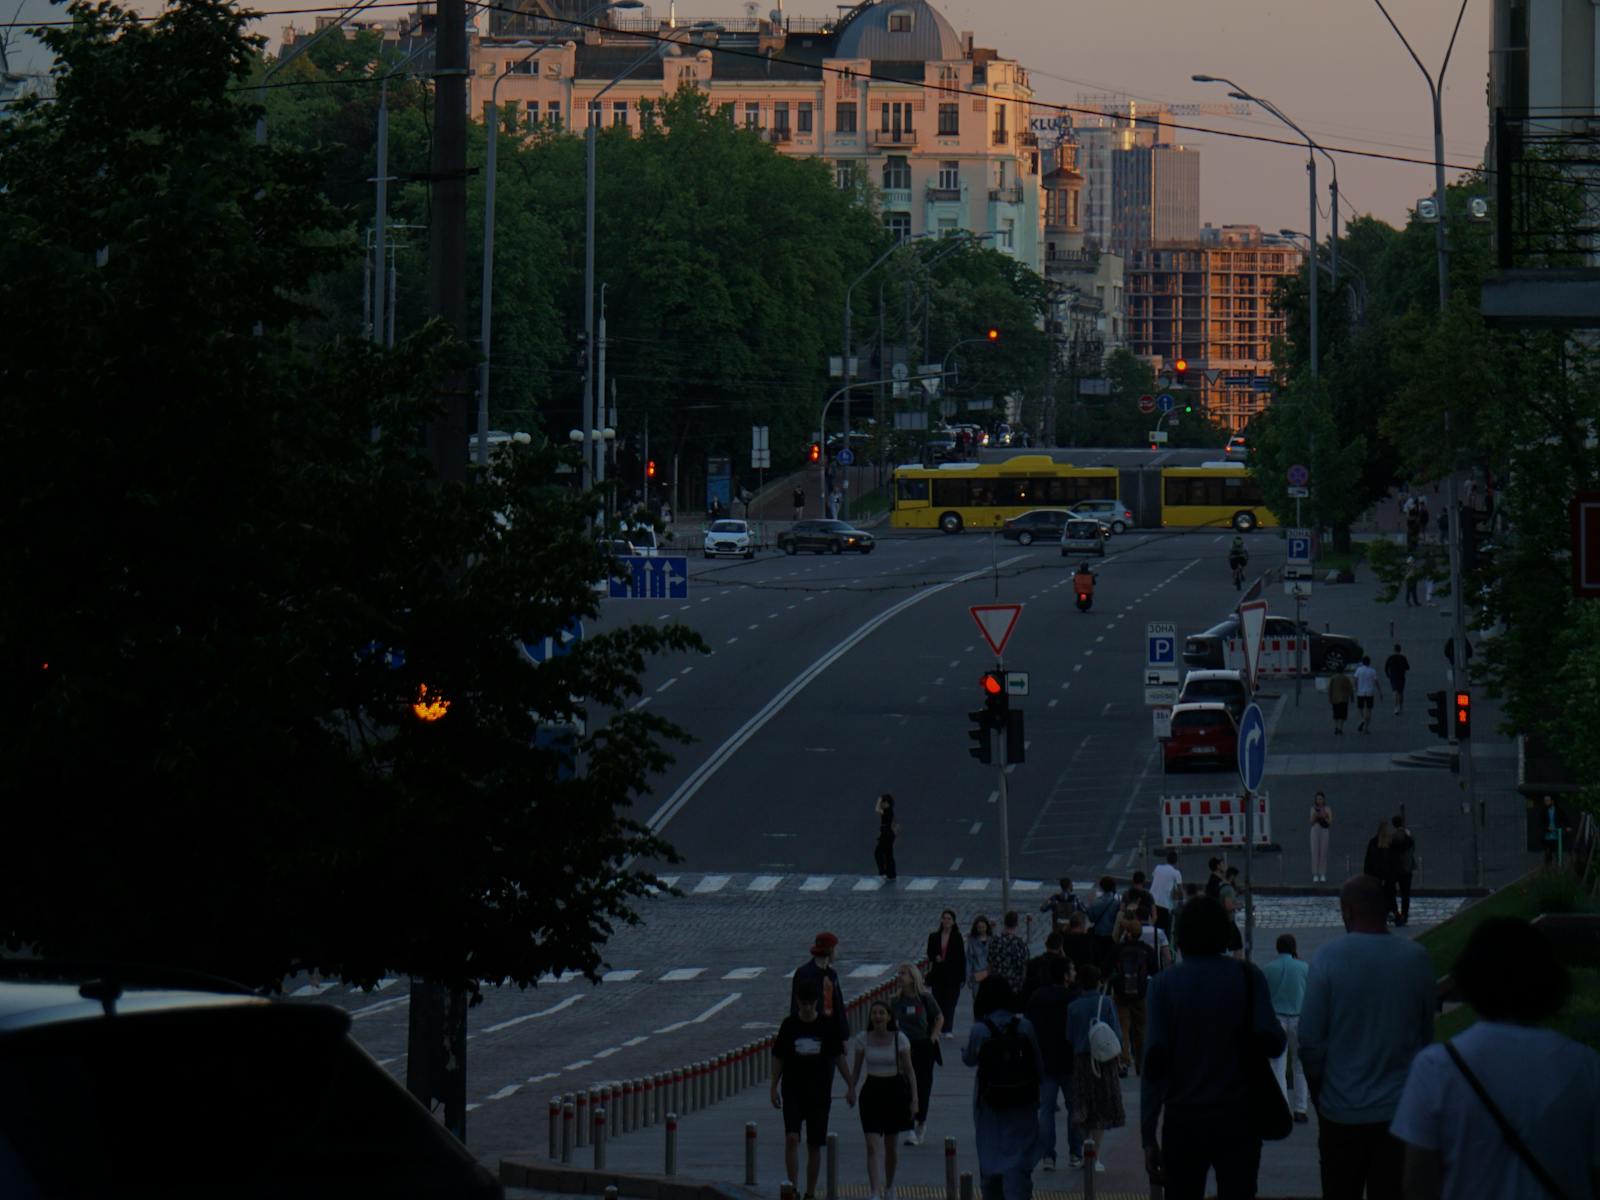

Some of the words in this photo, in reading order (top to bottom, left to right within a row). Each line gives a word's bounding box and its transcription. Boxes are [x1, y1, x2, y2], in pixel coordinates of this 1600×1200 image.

[1293, 540, 1304, 557] P
[1149, 625, 1174, 633] ЗОНА
[1155, 639, 1170, 660] P
